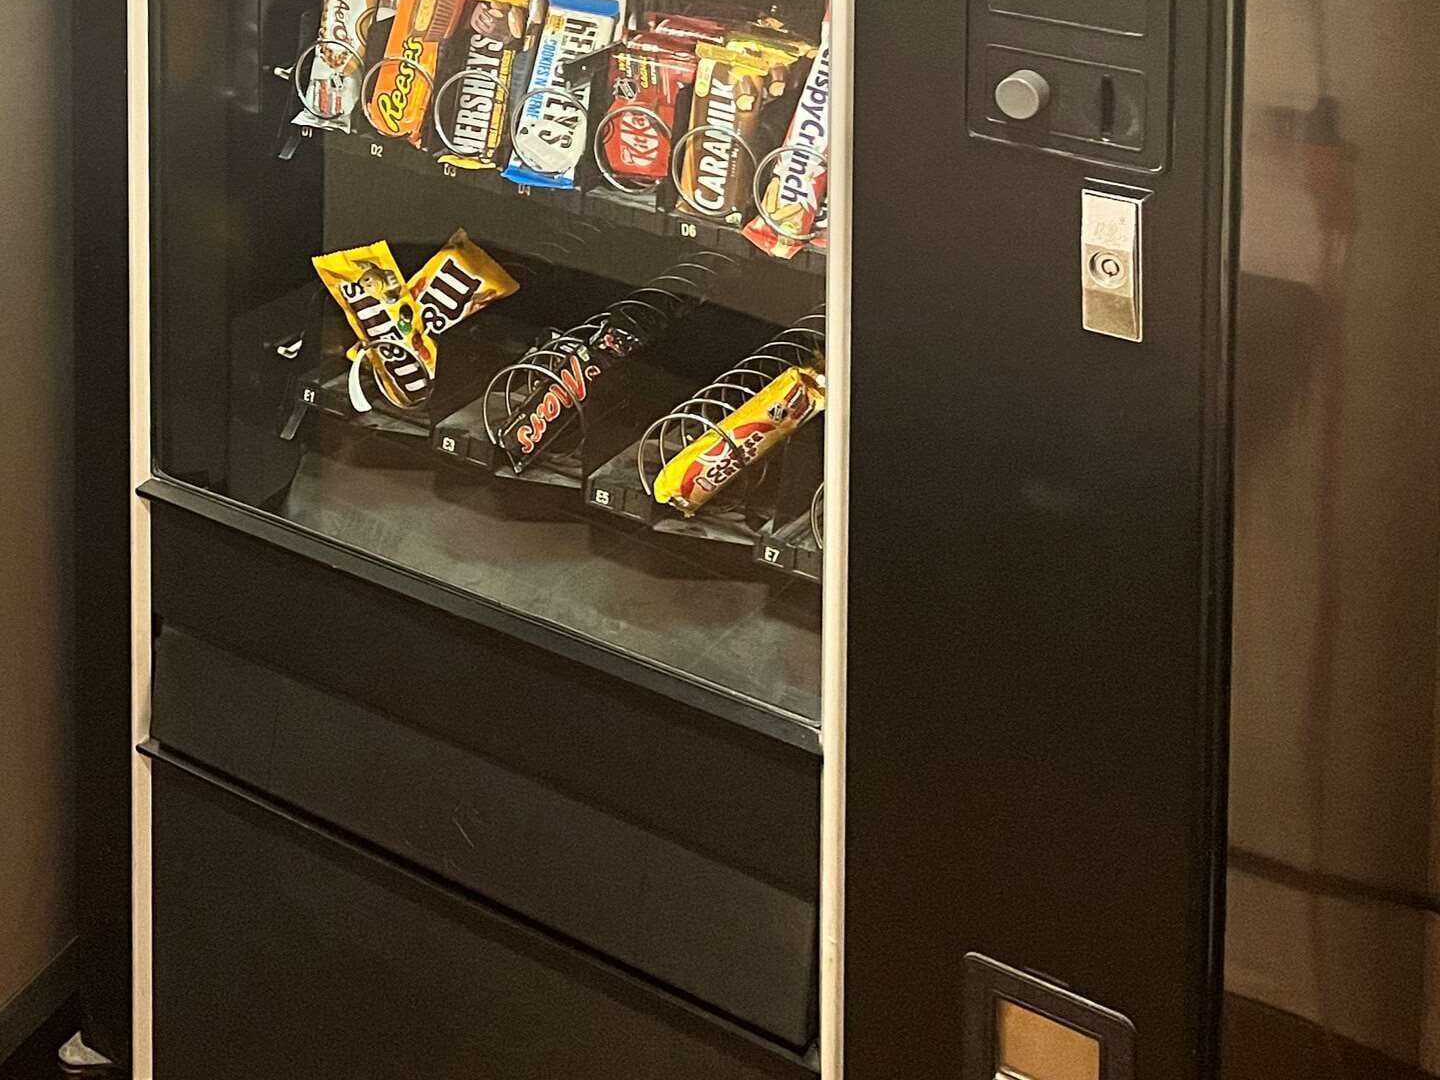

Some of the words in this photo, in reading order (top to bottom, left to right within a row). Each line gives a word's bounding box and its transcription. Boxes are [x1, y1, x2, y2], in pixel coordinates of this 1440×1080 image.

[538, 38, 560, 81] COOKIES
[377, 35, 425, 133] Reese's
[453, 33, 504, 157] HERSHEY'S
[370, 143, 383, 158] D2
[693, 77, 737, 211] CARAMILK
[680, 223, 697, 238] D6
[303, 388, 316, 403] E1
[516, 354, 587, 454] Mars
[442, 436, 456, 452] E3
[595, 489, 610, 505] E5
[764, 545, 781, 563] E7
